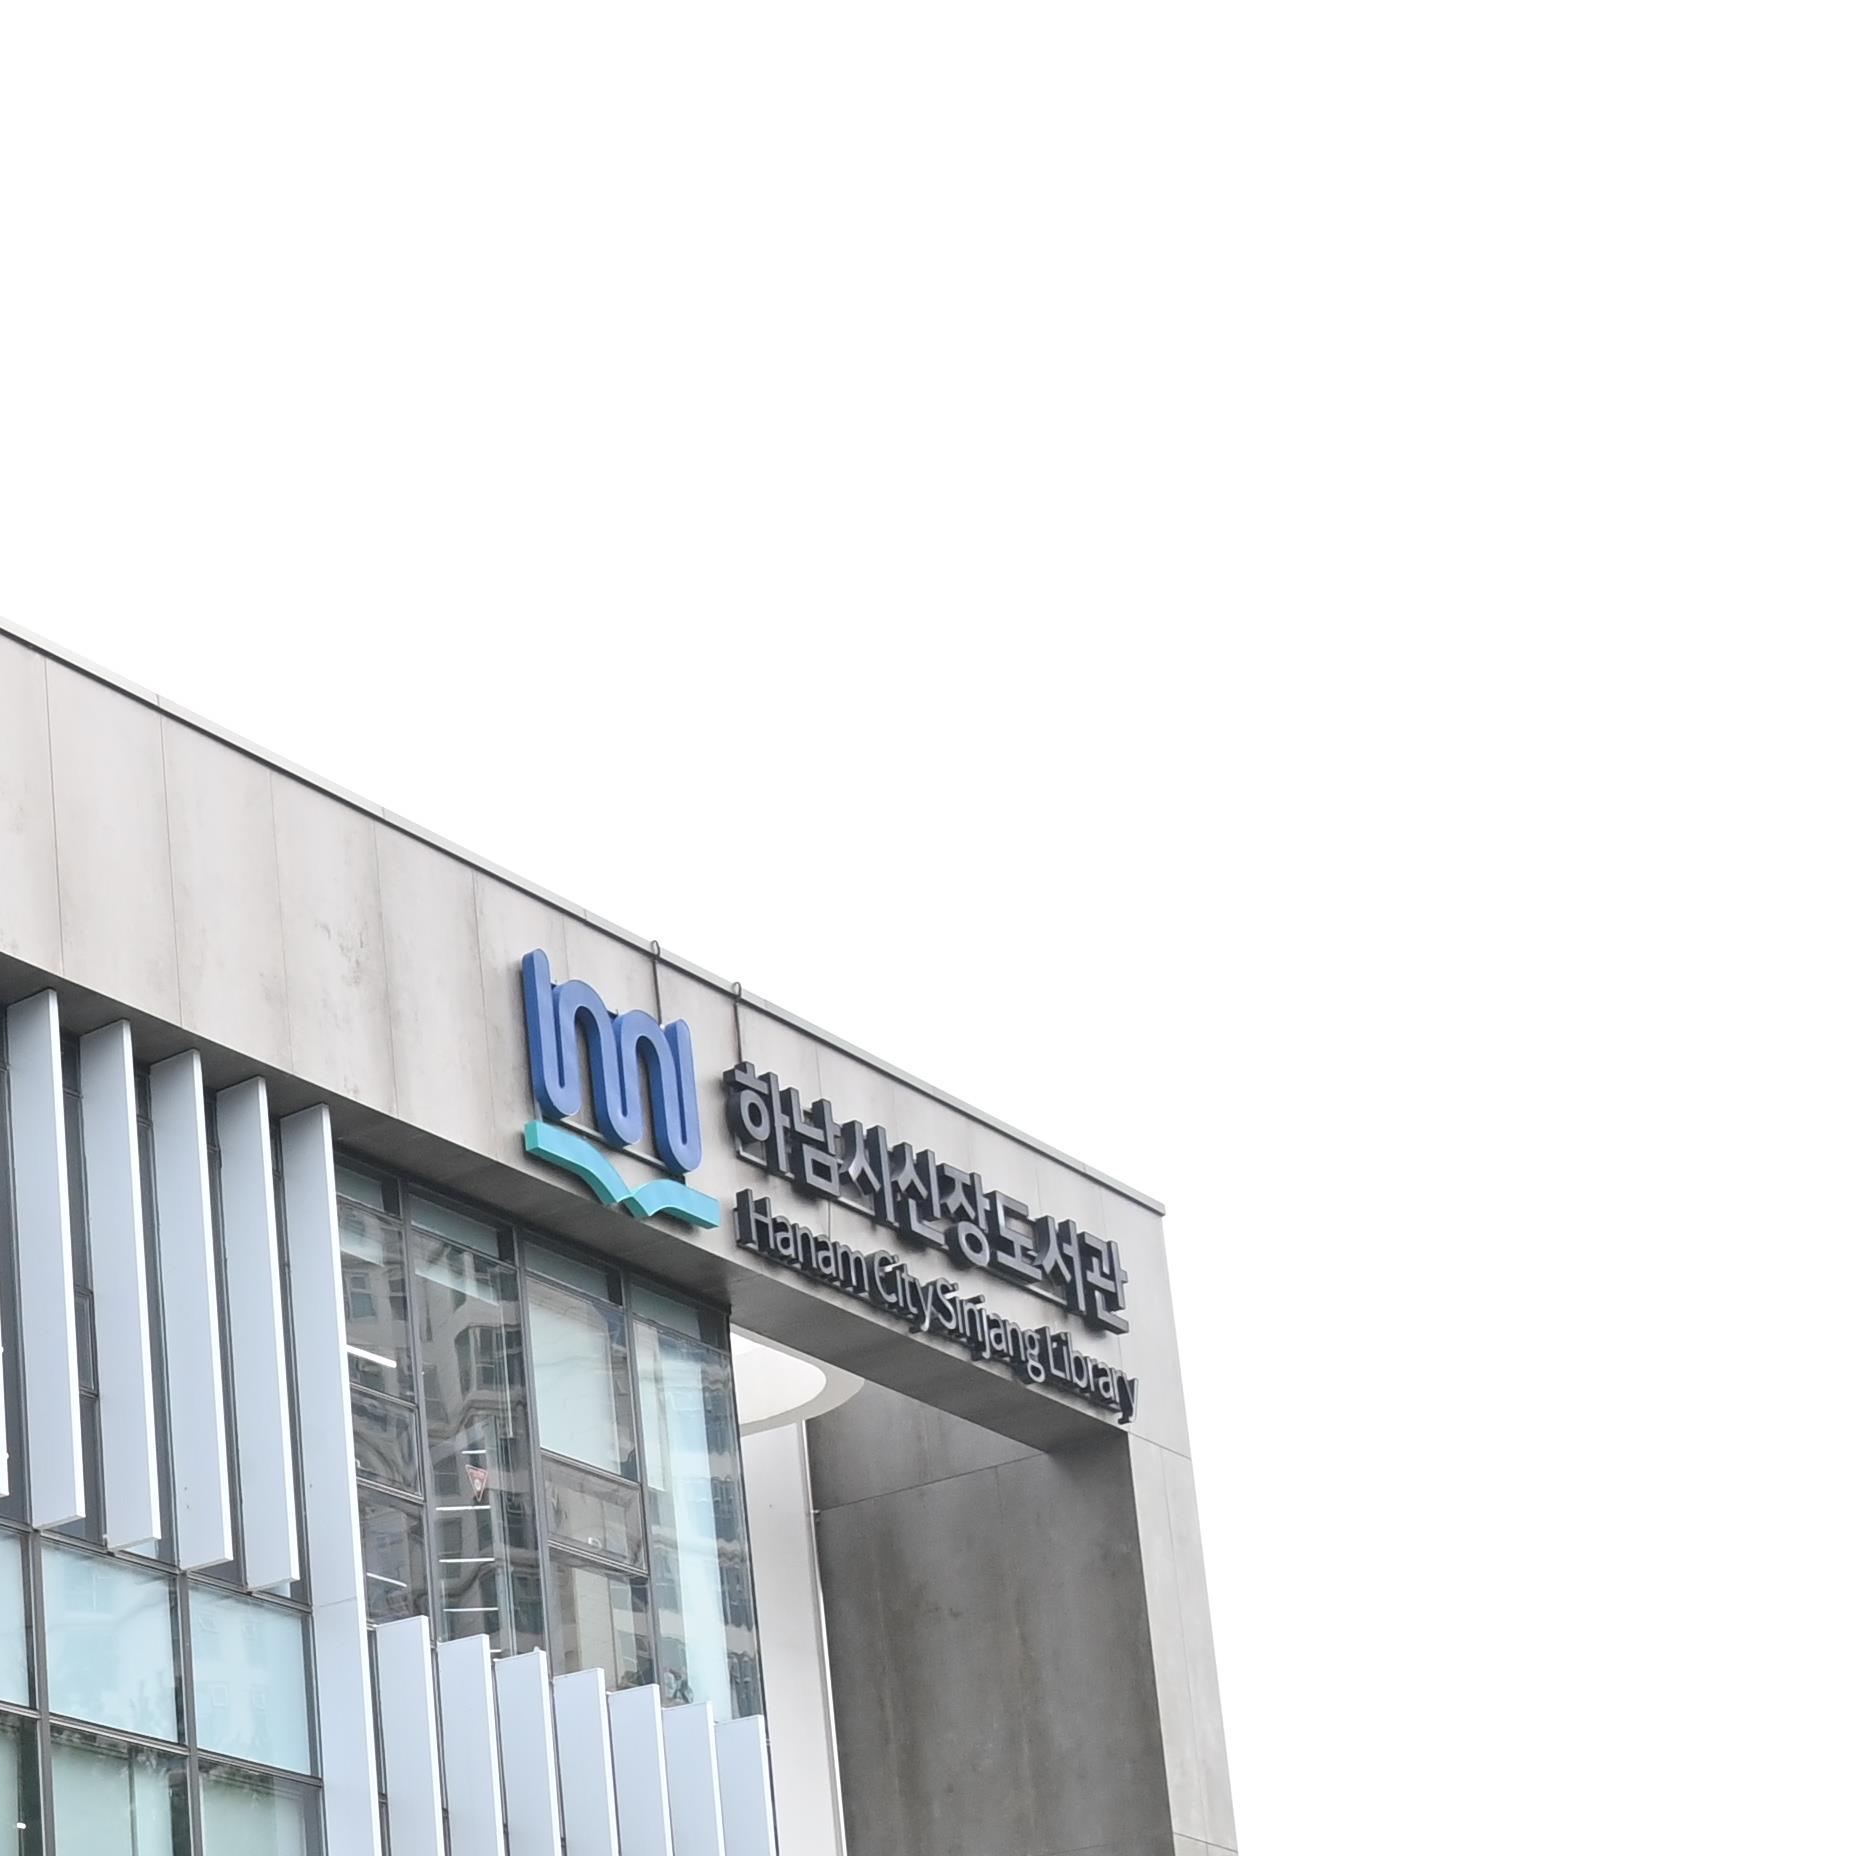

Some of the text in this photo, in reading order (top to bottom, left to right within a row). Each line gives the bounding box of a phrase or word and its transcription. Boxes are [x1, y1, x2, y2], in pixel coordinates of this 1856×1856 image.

[724, 1061, 1129, 1334] 하남시신장도서관
[734, 1189, 1138, 1424] Hanam City Sinjang Library
